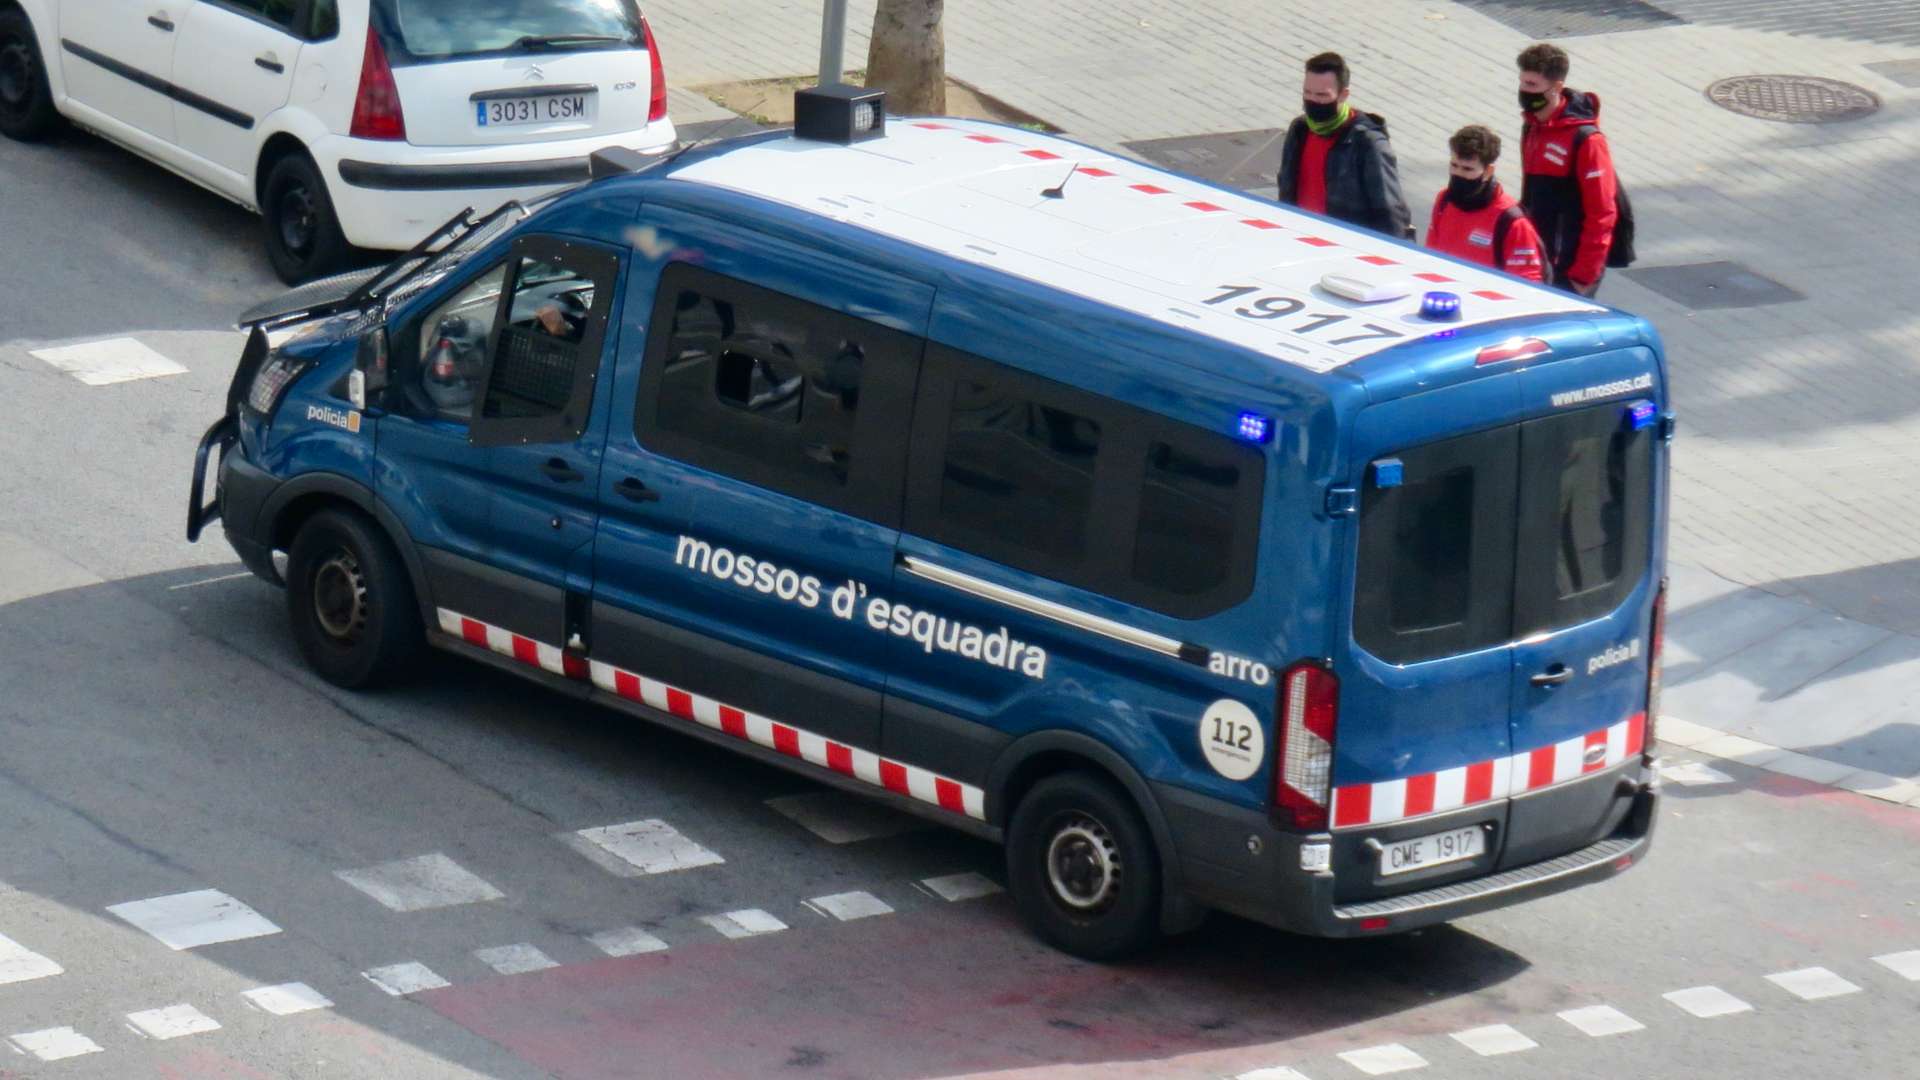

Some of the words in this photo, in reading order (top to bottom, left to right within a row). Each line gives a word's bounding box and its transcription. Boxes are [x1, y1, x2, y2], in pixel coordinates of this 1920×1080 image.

[492, 101, 538, 122] 3031
[548, 98, 585, 118] CSM
[1201, 284, 1405, 346] 1917
[1550, 372, 1653, 407] www.mossos.cat
[307, 405, 348, 429] policia
[675, 534, 821, 609] mossos
[831, 579, 1047, 680] d'esquadra
[1208, 651, 1270, 686] arro
[1212, 717, 1253, 751] 112
[1391, 842, 1424, 869] CME
[1436, 831, 1474, 859] 1917
